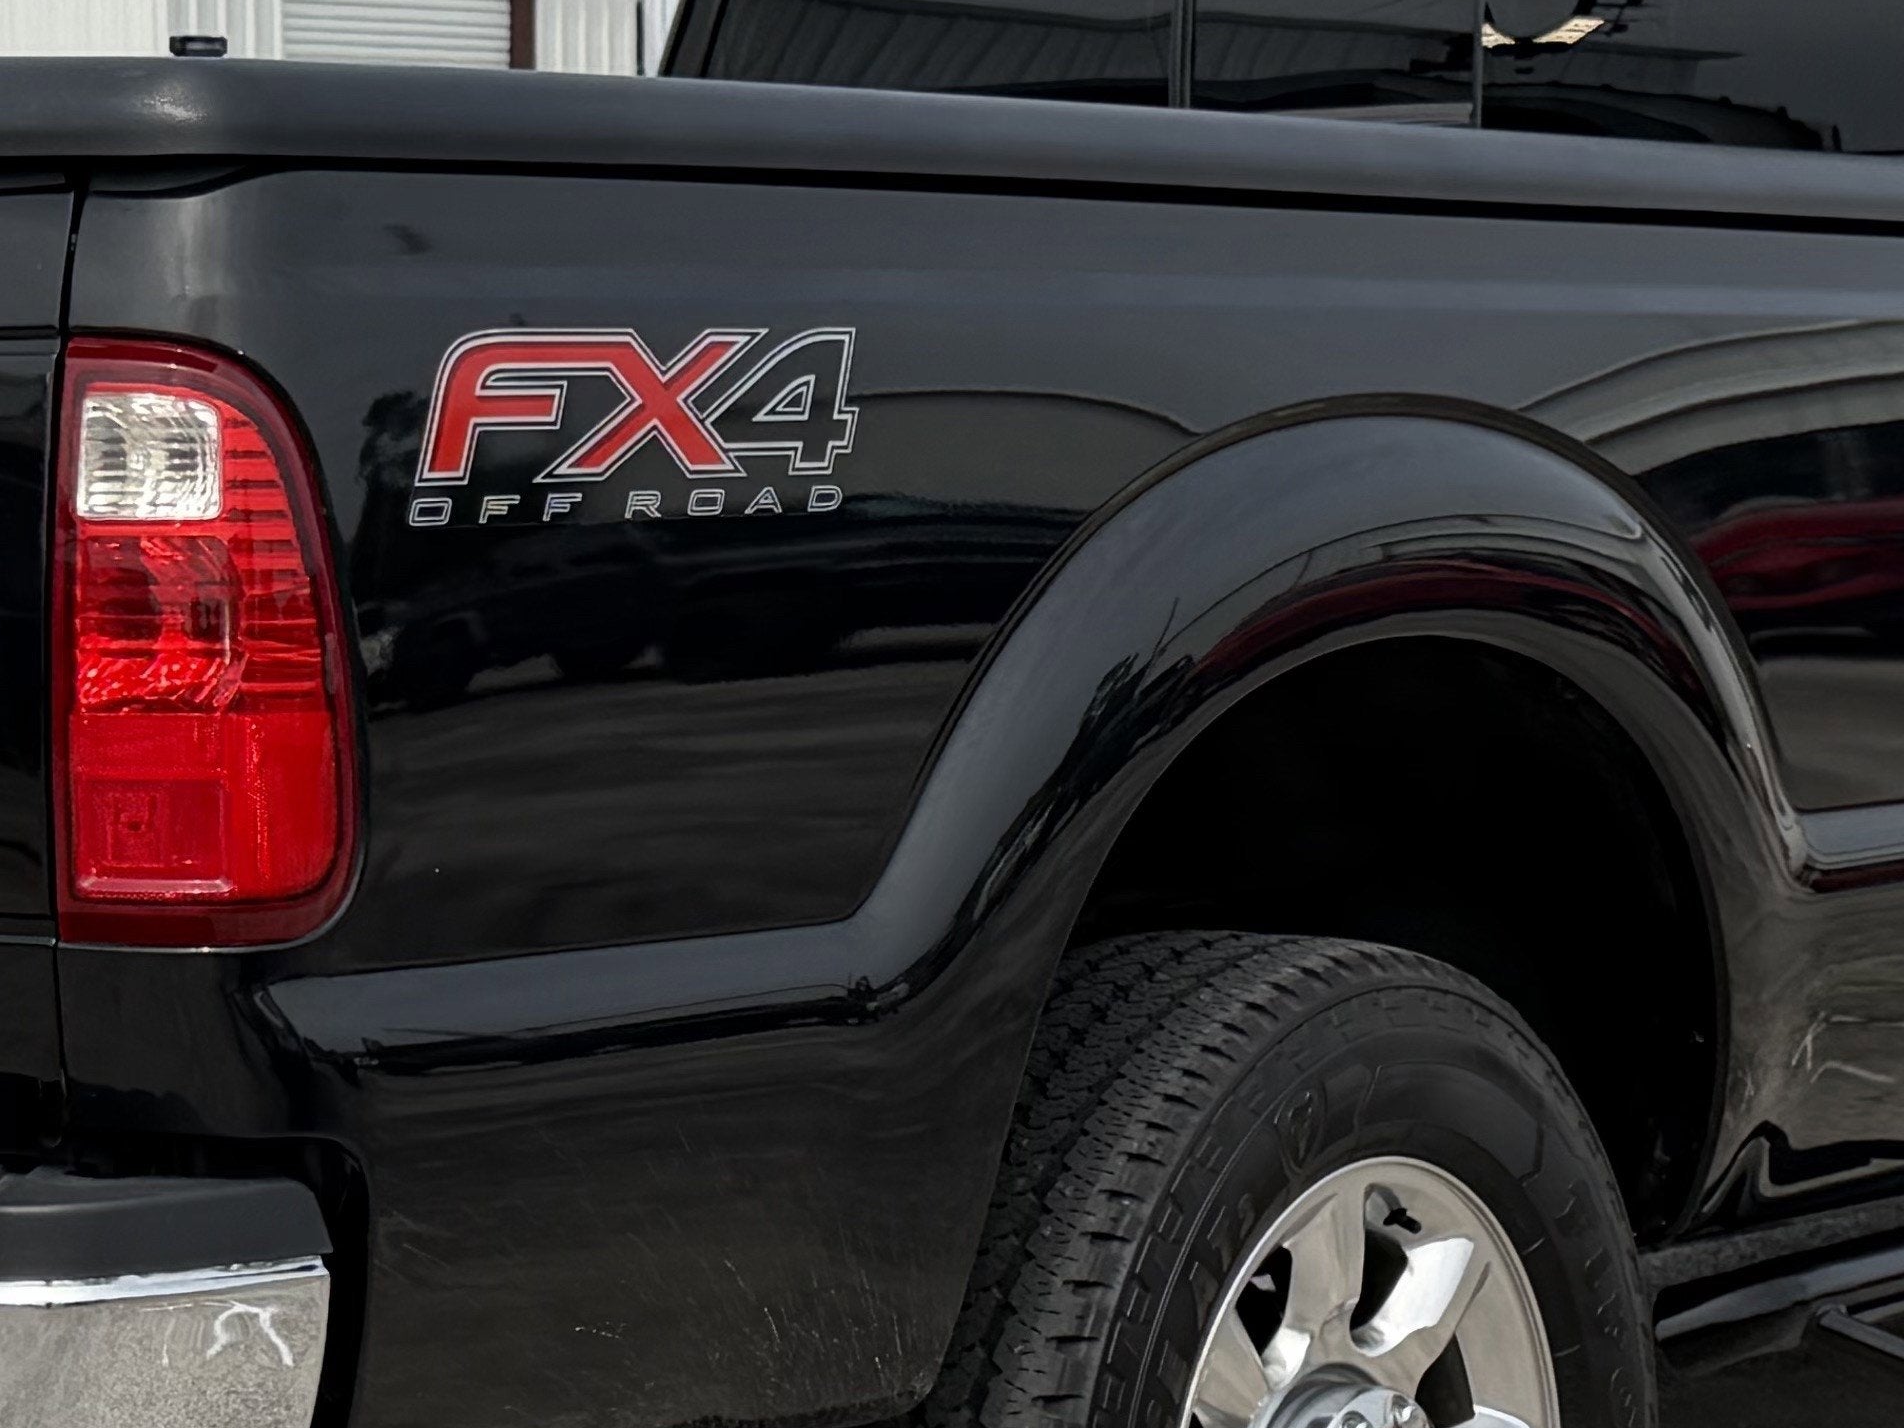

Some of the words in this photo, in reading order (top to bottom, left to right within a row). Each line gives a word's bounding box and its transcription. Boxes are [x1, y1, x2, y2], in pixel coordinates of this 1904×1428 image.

[415, 327, 859, 486] FX4
[408, 492, 582, 527] OFF
[625, 485, 843, 520] ROAD
